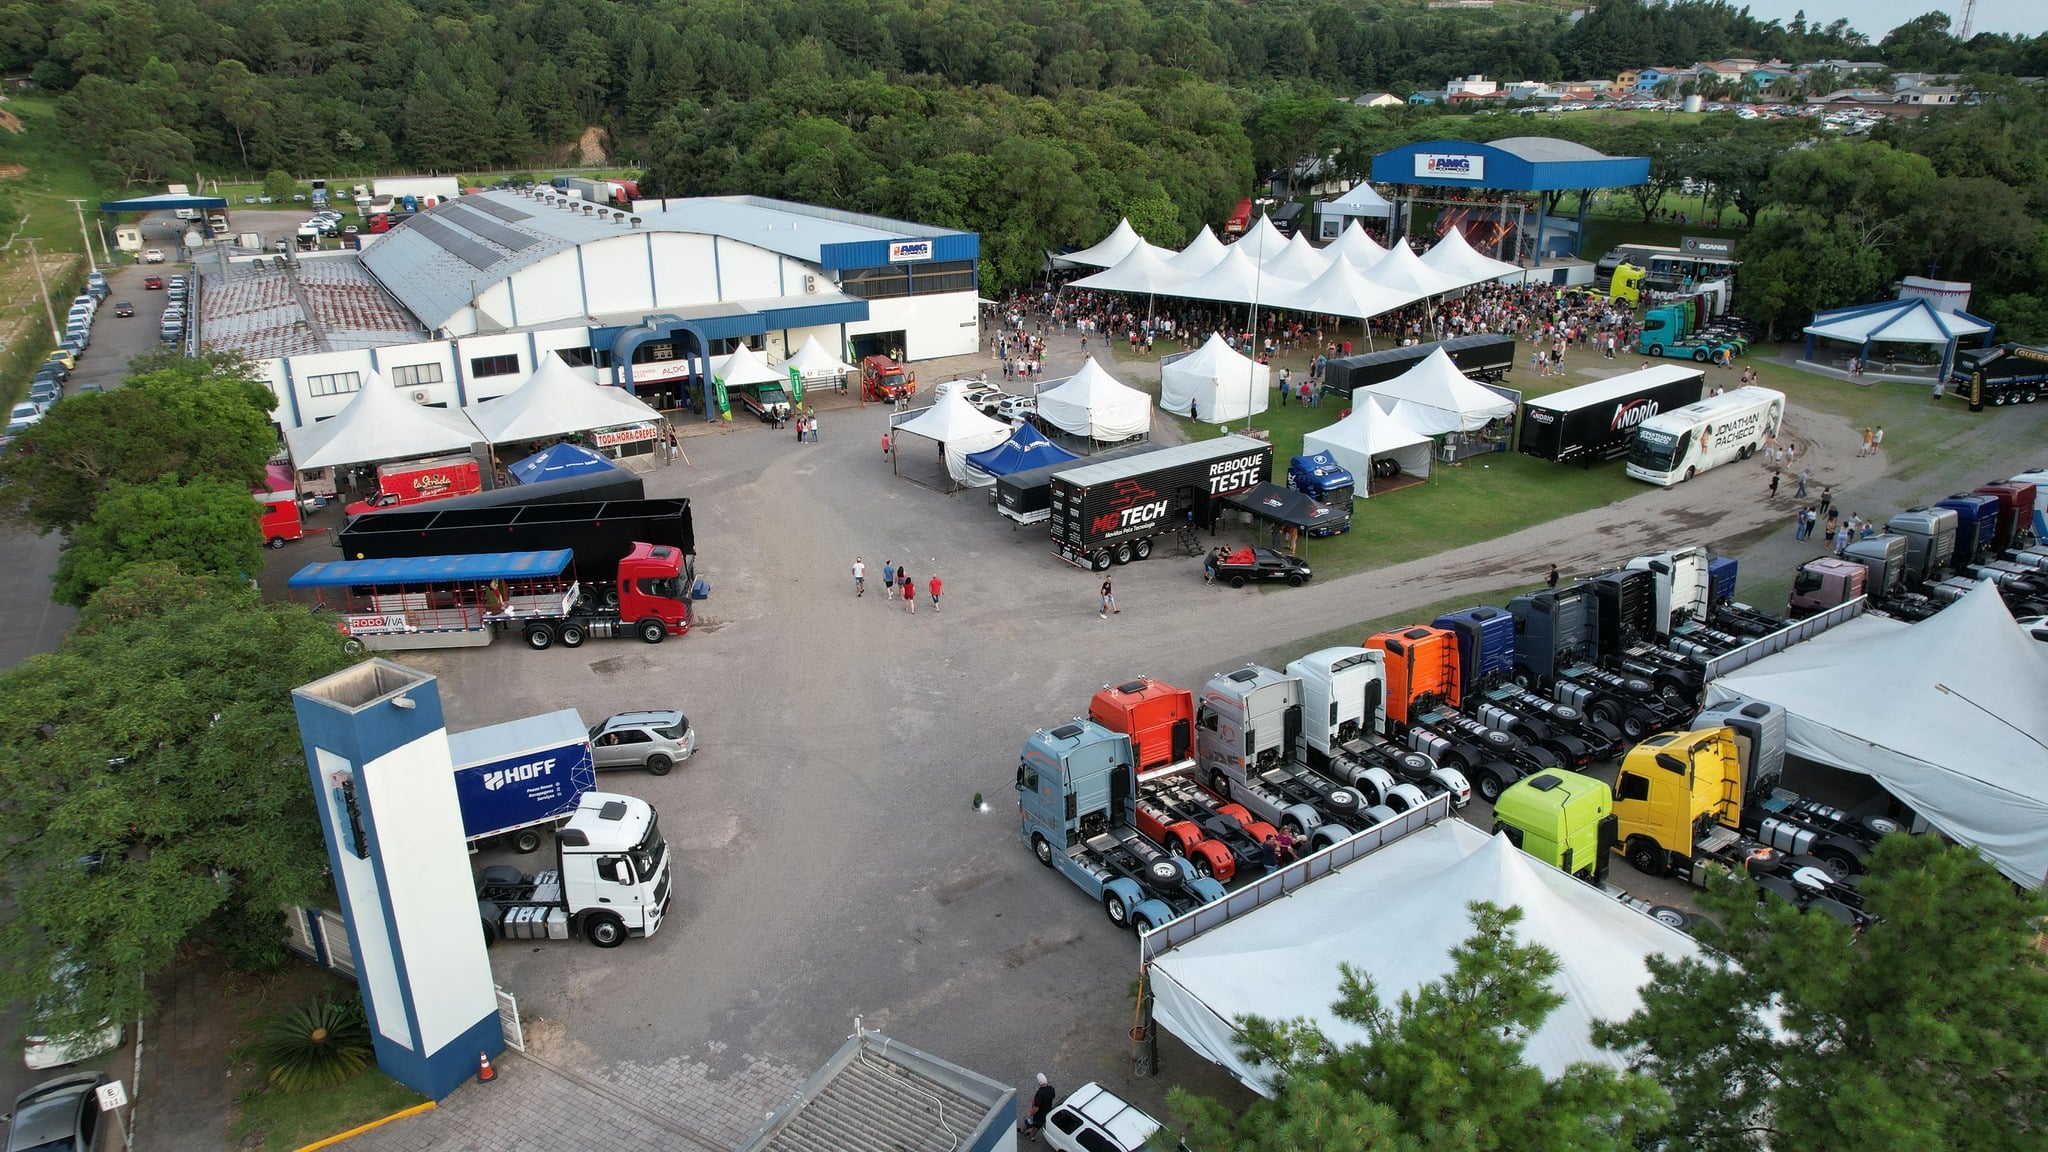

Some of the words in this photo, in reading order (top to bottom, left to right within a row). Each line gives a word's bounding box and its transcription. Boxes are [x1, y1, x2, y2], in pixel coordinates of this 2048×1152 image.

[1436, 159, 1469, 168] AMG
[900, 244, 927, 252] AMG
[1699, 243, 1728, 251] SCANIA
[2019, 350, 2048, 361] GUERR
[662, 365, 686, 375] ALDO
[1530, 409, 1554, 422] ANDRIO
[1715, 412, 1759, 437] JONATHAN
[598, 434, 616, 444] TODA
[616, 431, 633, 441] HORA
[635, 428, 656, 439] CREPES
[1640, 430, 1673, 441] JONATHAN
[1715, 426, 1755, 448] PACHECO
[1209, 453, 1264, 476] REBOQUE
[1210, 467, 1260, 495] TESTE
[1090, 500, 1168, 536] MGTECH
[504, 758, 557, 784] HOFF
